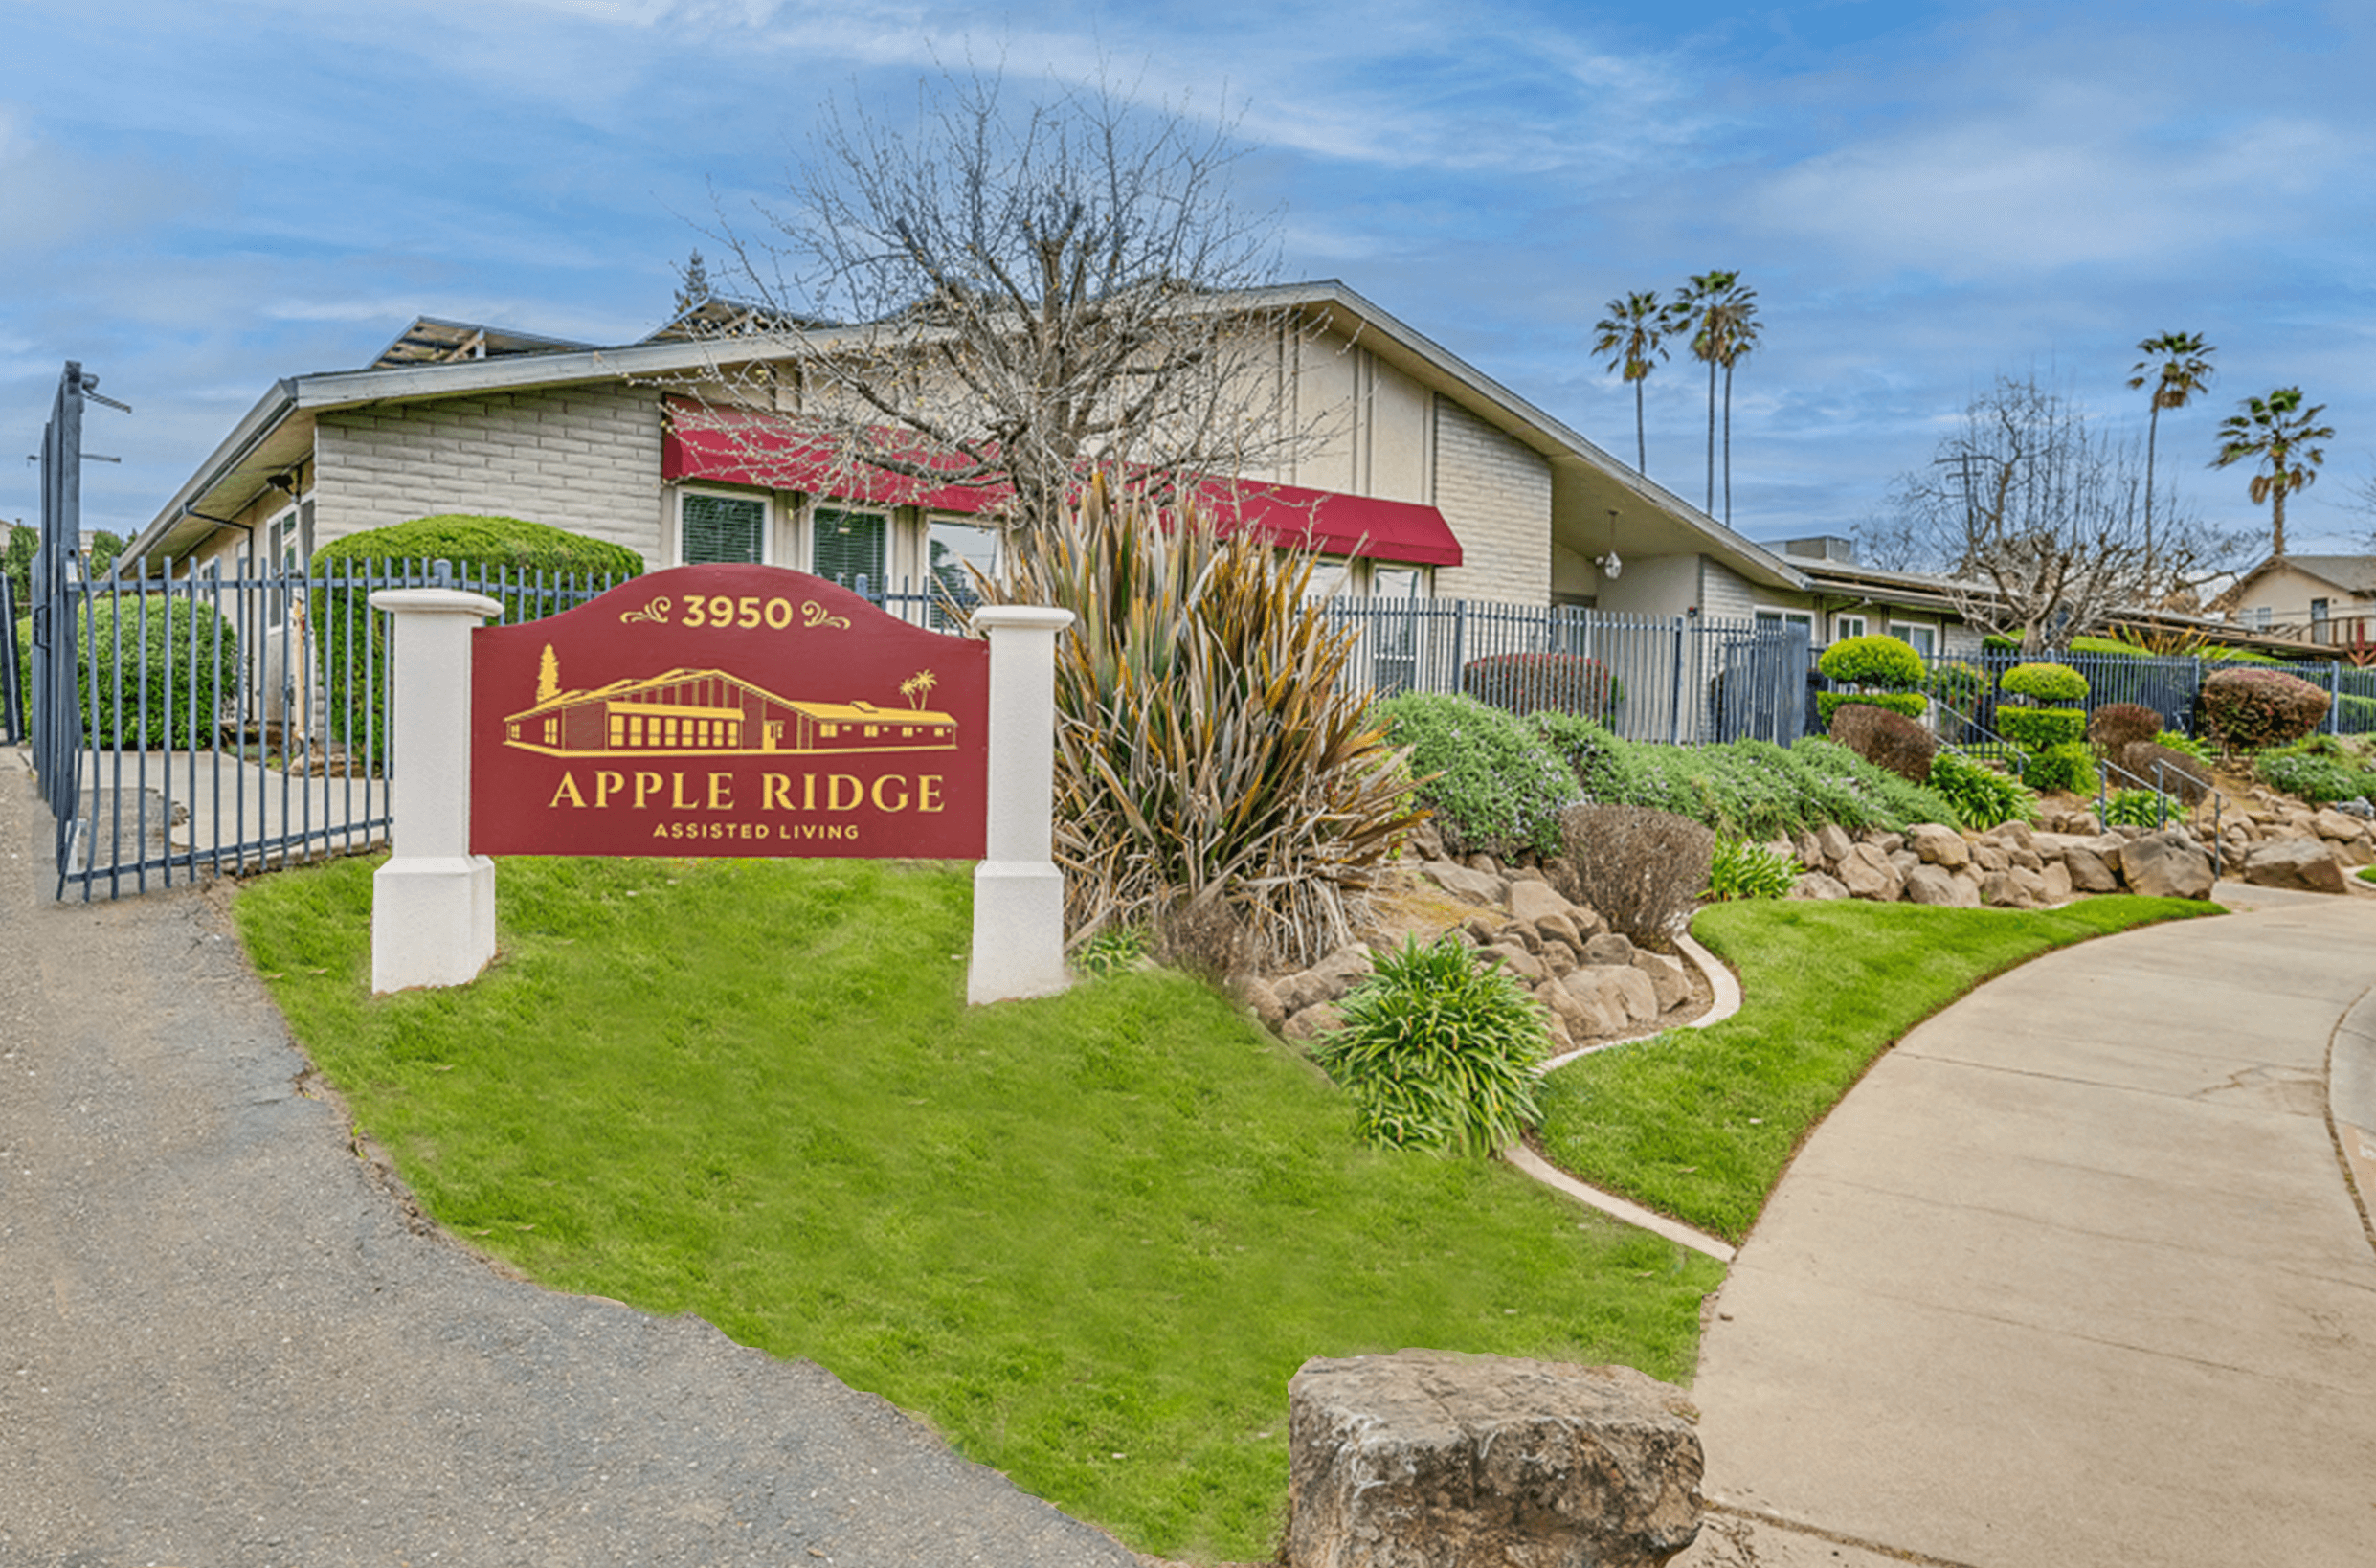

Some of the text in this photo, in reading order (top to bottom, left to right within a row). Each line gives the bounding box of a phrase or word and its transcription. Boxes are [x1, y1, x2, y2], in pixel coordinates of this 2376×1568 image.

[681, 594, 794, 631] 3950
[549, 770, 946, 814] APPLE RIDGE
[652, 822, 860, 840] ASSISTED LIVING
